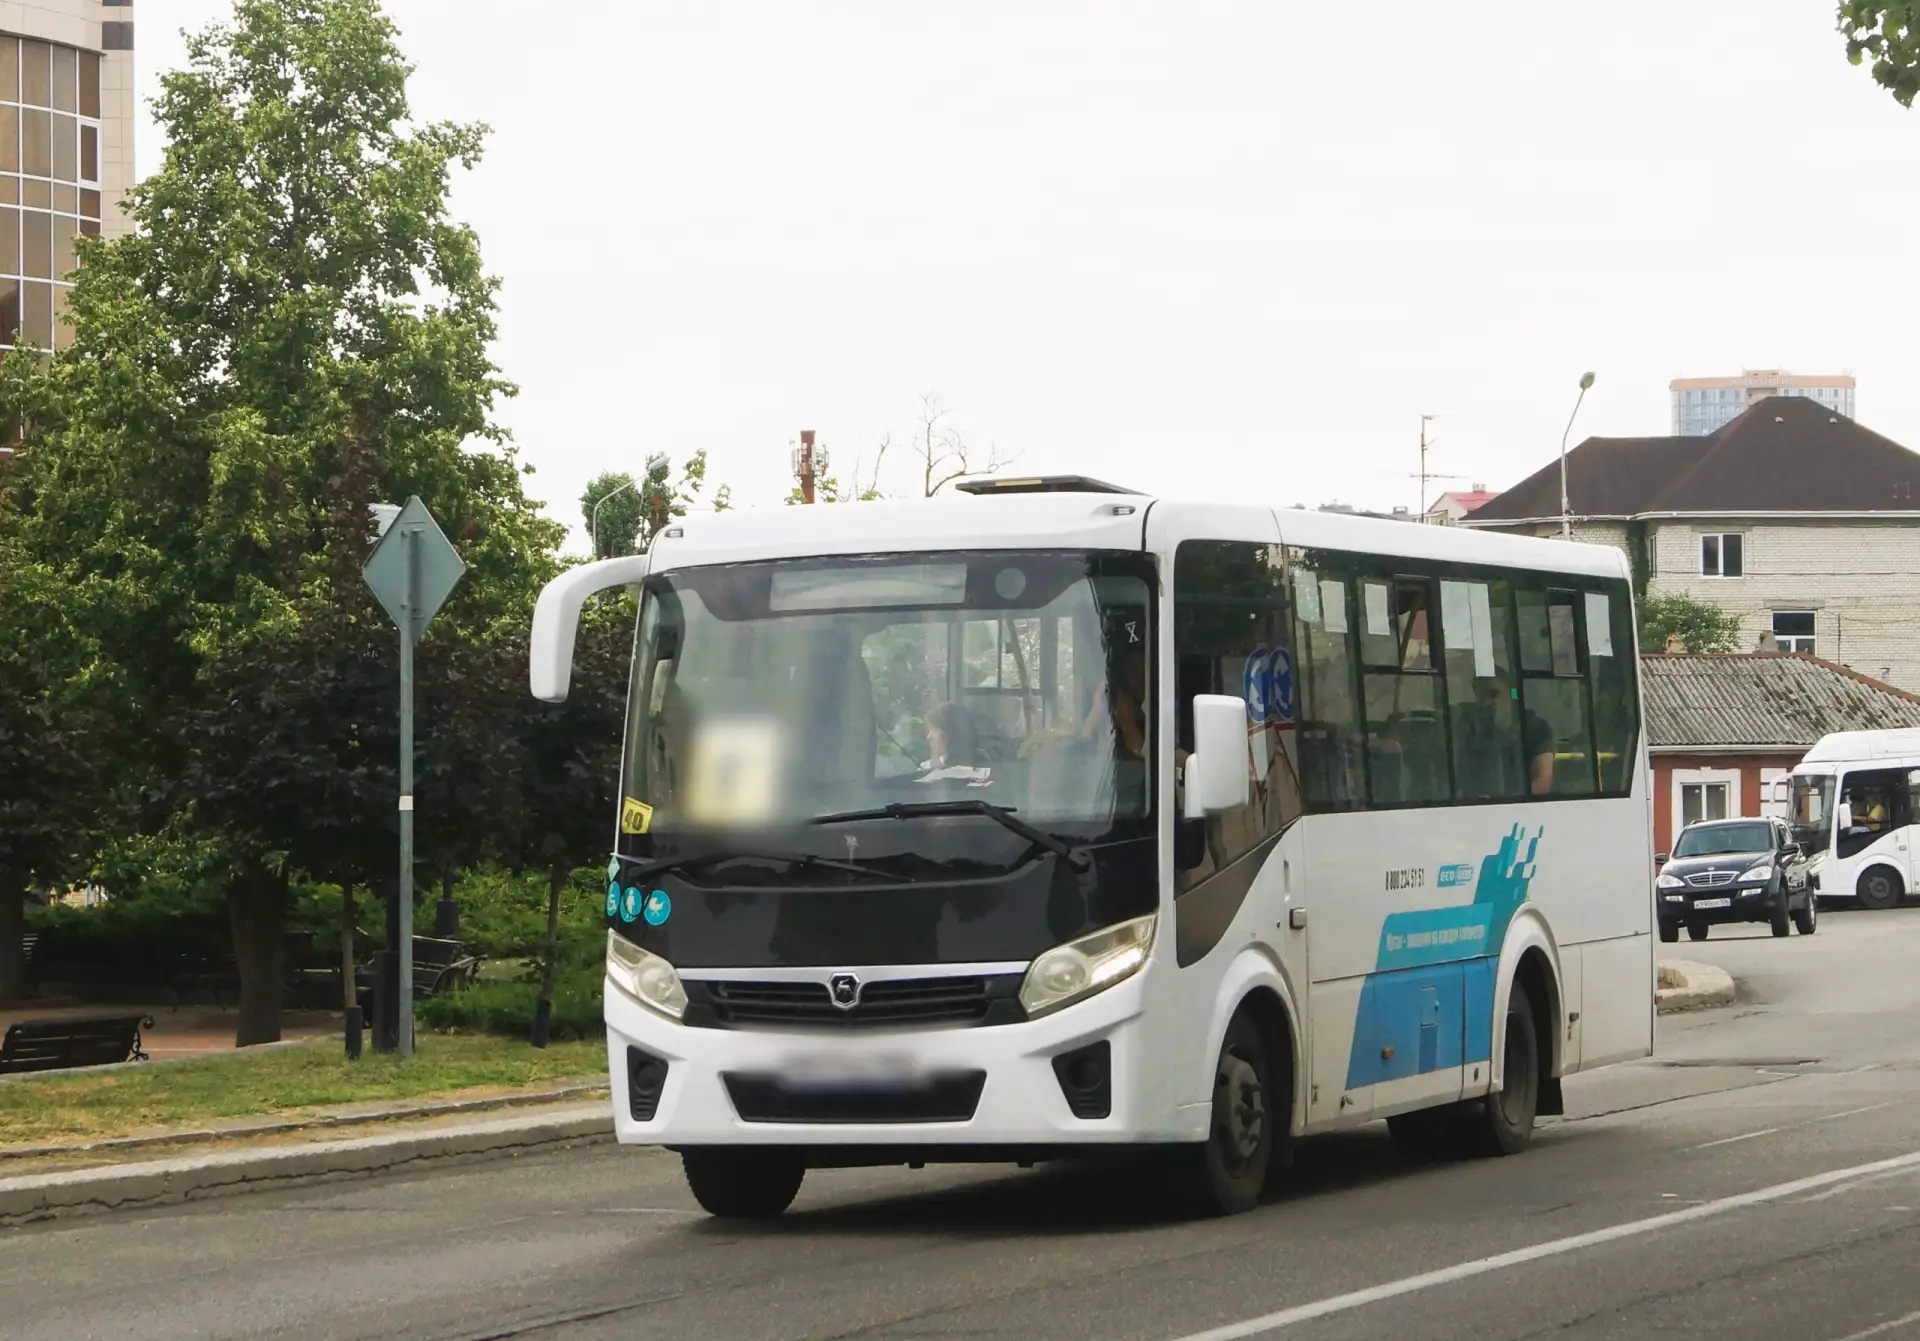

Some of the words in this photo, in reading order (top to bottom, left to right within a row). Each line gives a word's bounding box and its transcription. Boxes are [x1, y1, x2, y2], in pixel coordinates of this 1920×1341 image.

[625, 809, 644, 831] 40
[1400, 868, 1410, 889] 234
[1411, 867, 1418, 889] 51
[1418, 867, 1425, 888] 51
